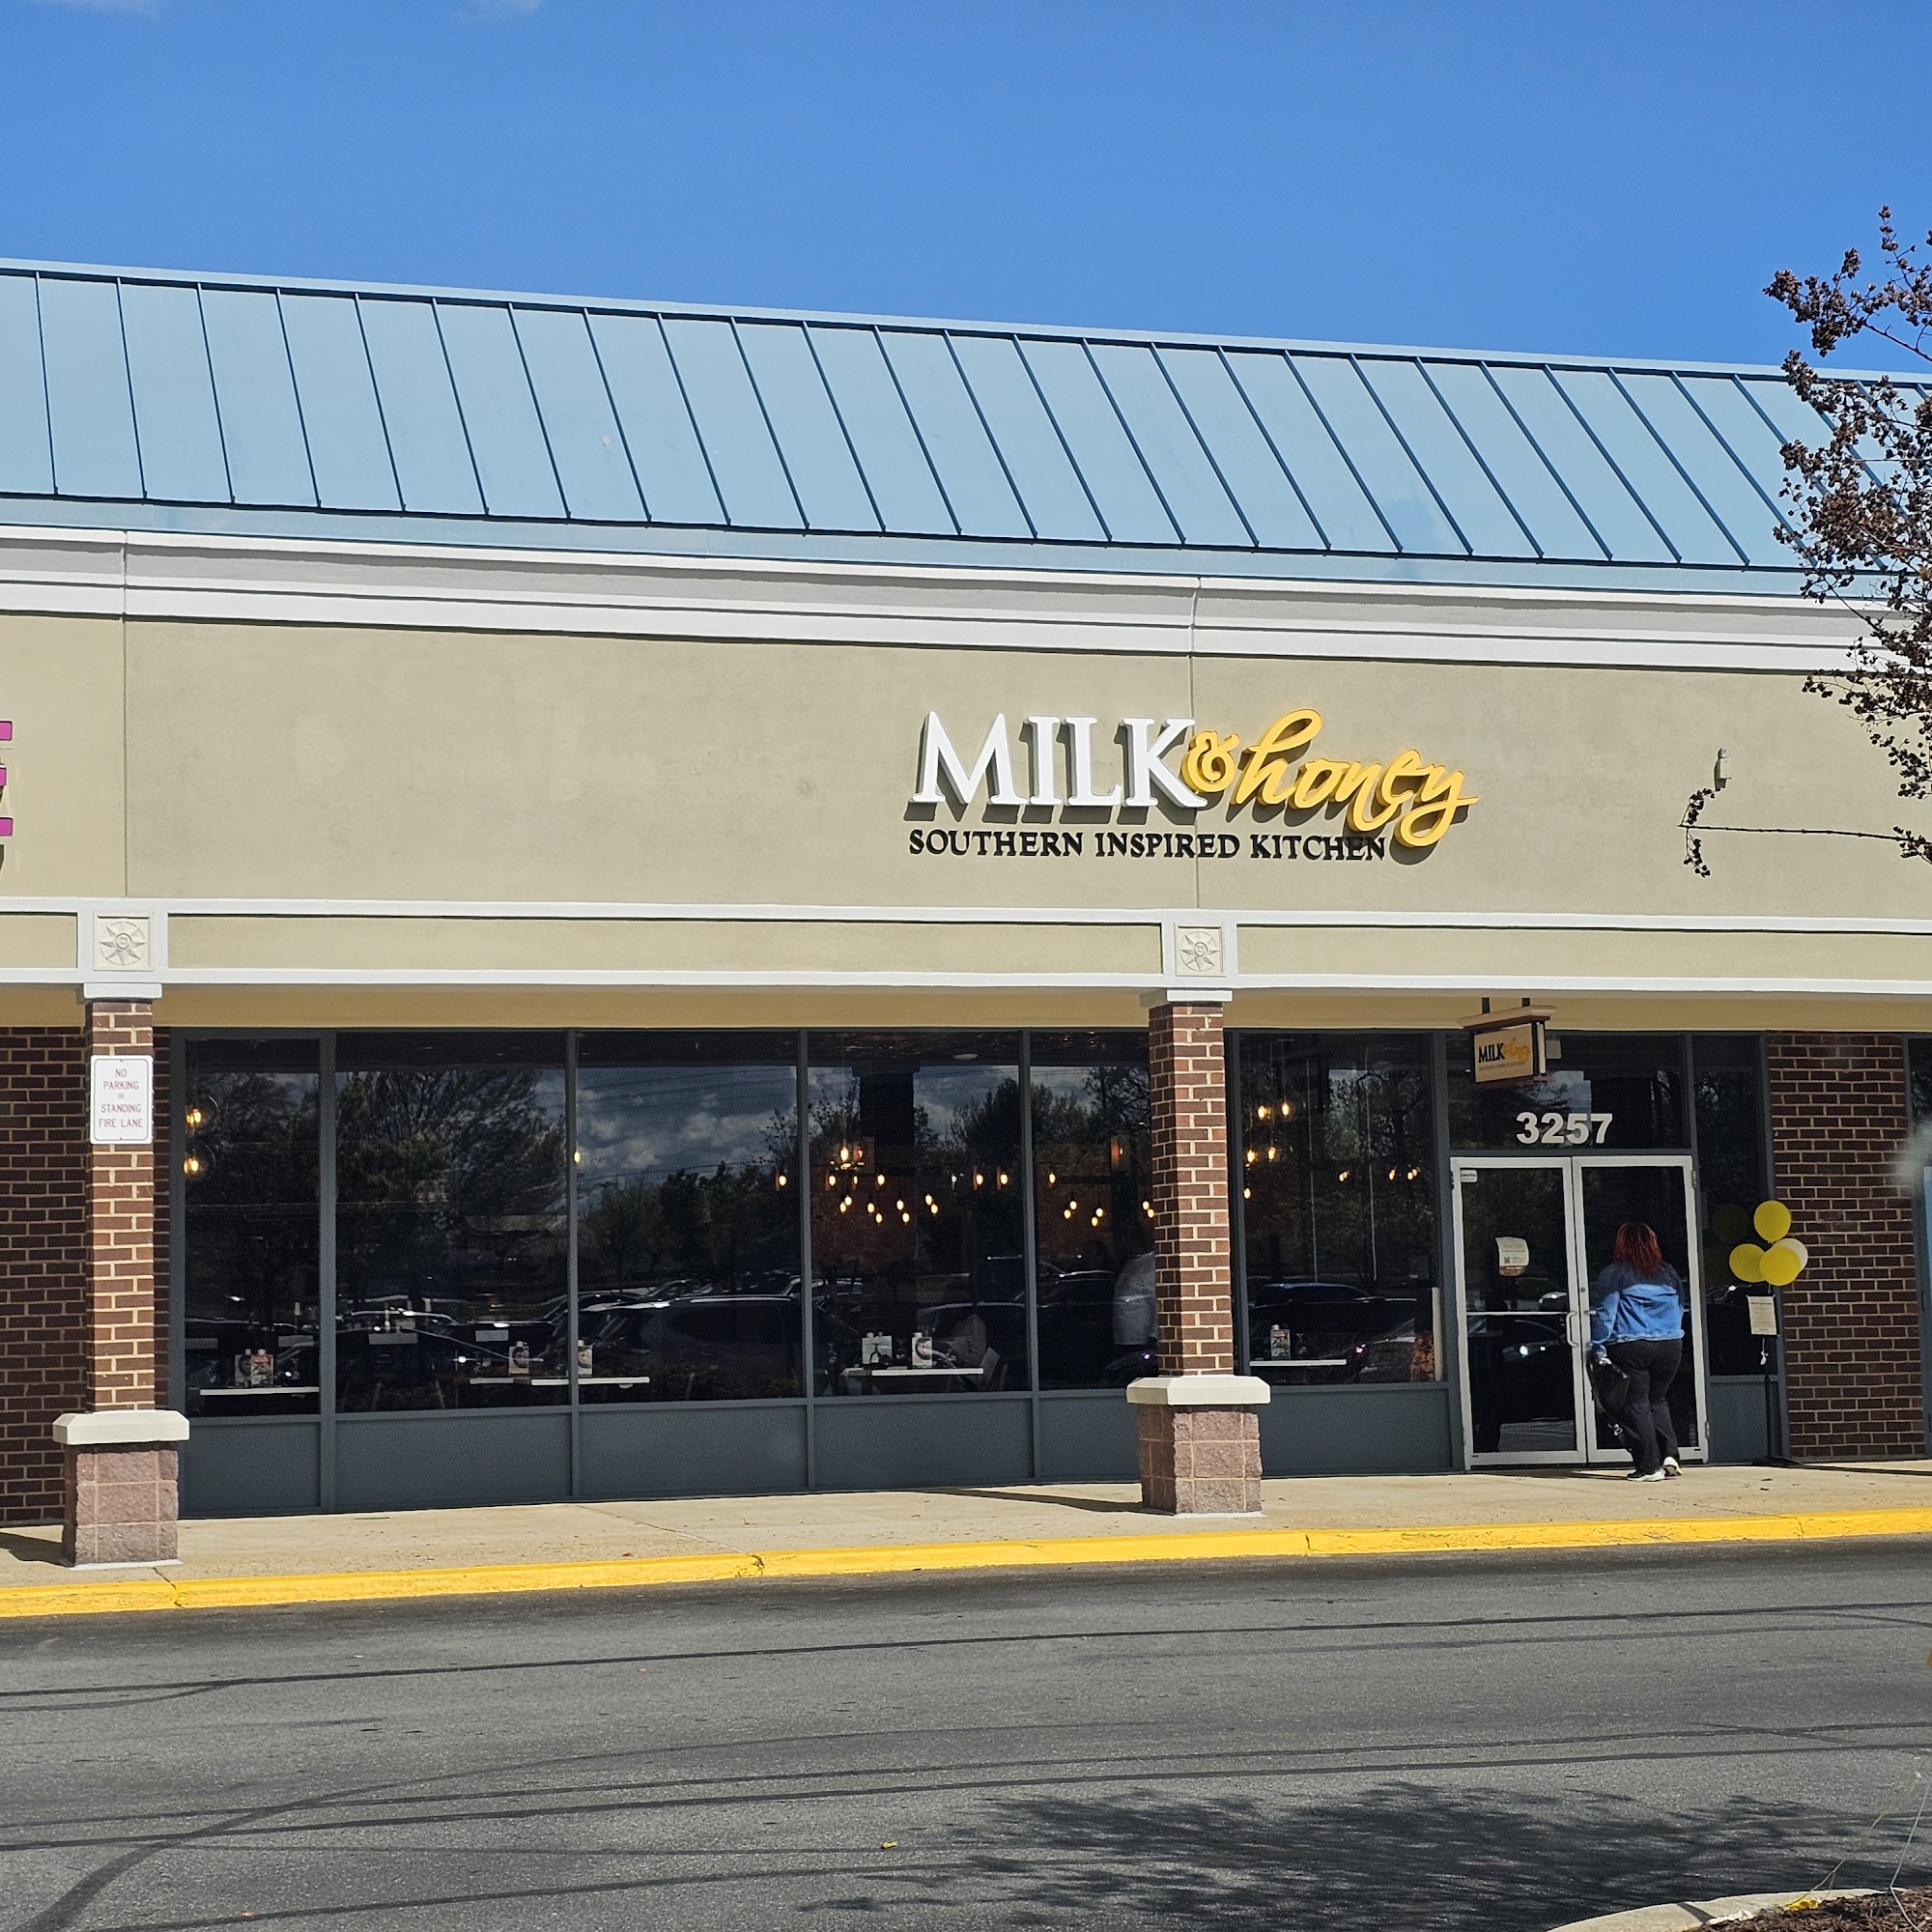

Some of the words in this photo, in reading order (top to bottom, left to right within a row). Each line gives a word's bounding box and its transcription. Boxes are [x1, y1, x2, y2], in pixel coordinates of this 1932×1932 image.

[912, 710, 1208, 808] MILK
[909, 829, 1084, 857] SOUTHERN
[1095, 831, 1240, 859] INSPIRED
[1250, 834, 1386, 862] KITCHEN
[1478, 1042, 1505, 1064] MILK
[115, 1068, 128, 1078] NO
[103, 1081, 139, 1090] PARKING
[100, 1103, 142, 1113] STANDING
[99, 1118, 117, 1127] FIRE
[121, 1118, 144, 1127] LANE
[1517, 1112, 1613, 1144] 3257
